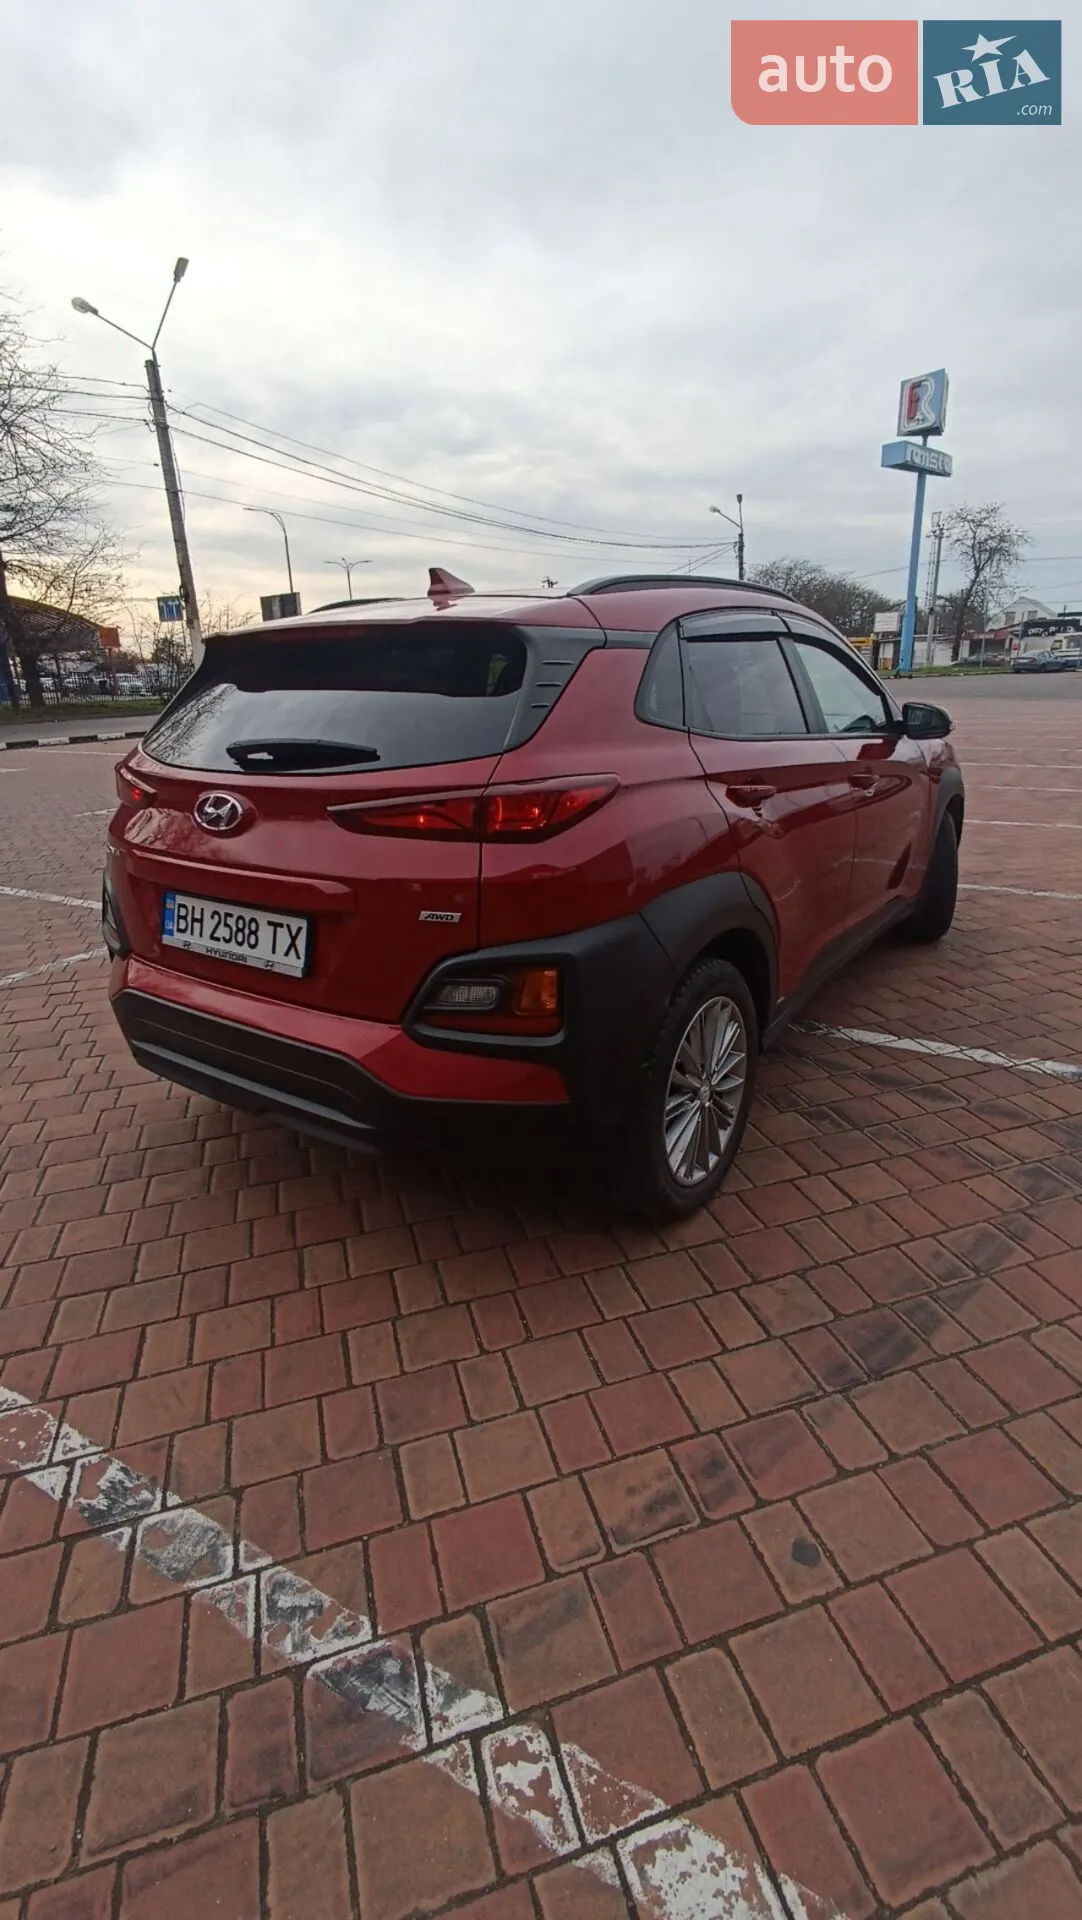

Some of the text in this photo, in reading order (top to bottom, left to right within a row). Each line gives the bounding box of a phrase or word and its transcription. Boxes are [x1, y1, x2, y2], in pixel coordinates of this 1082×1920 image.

[176, 903, 303, 960] BH 2588 TX
[424, 912, 454, 921] AWD
